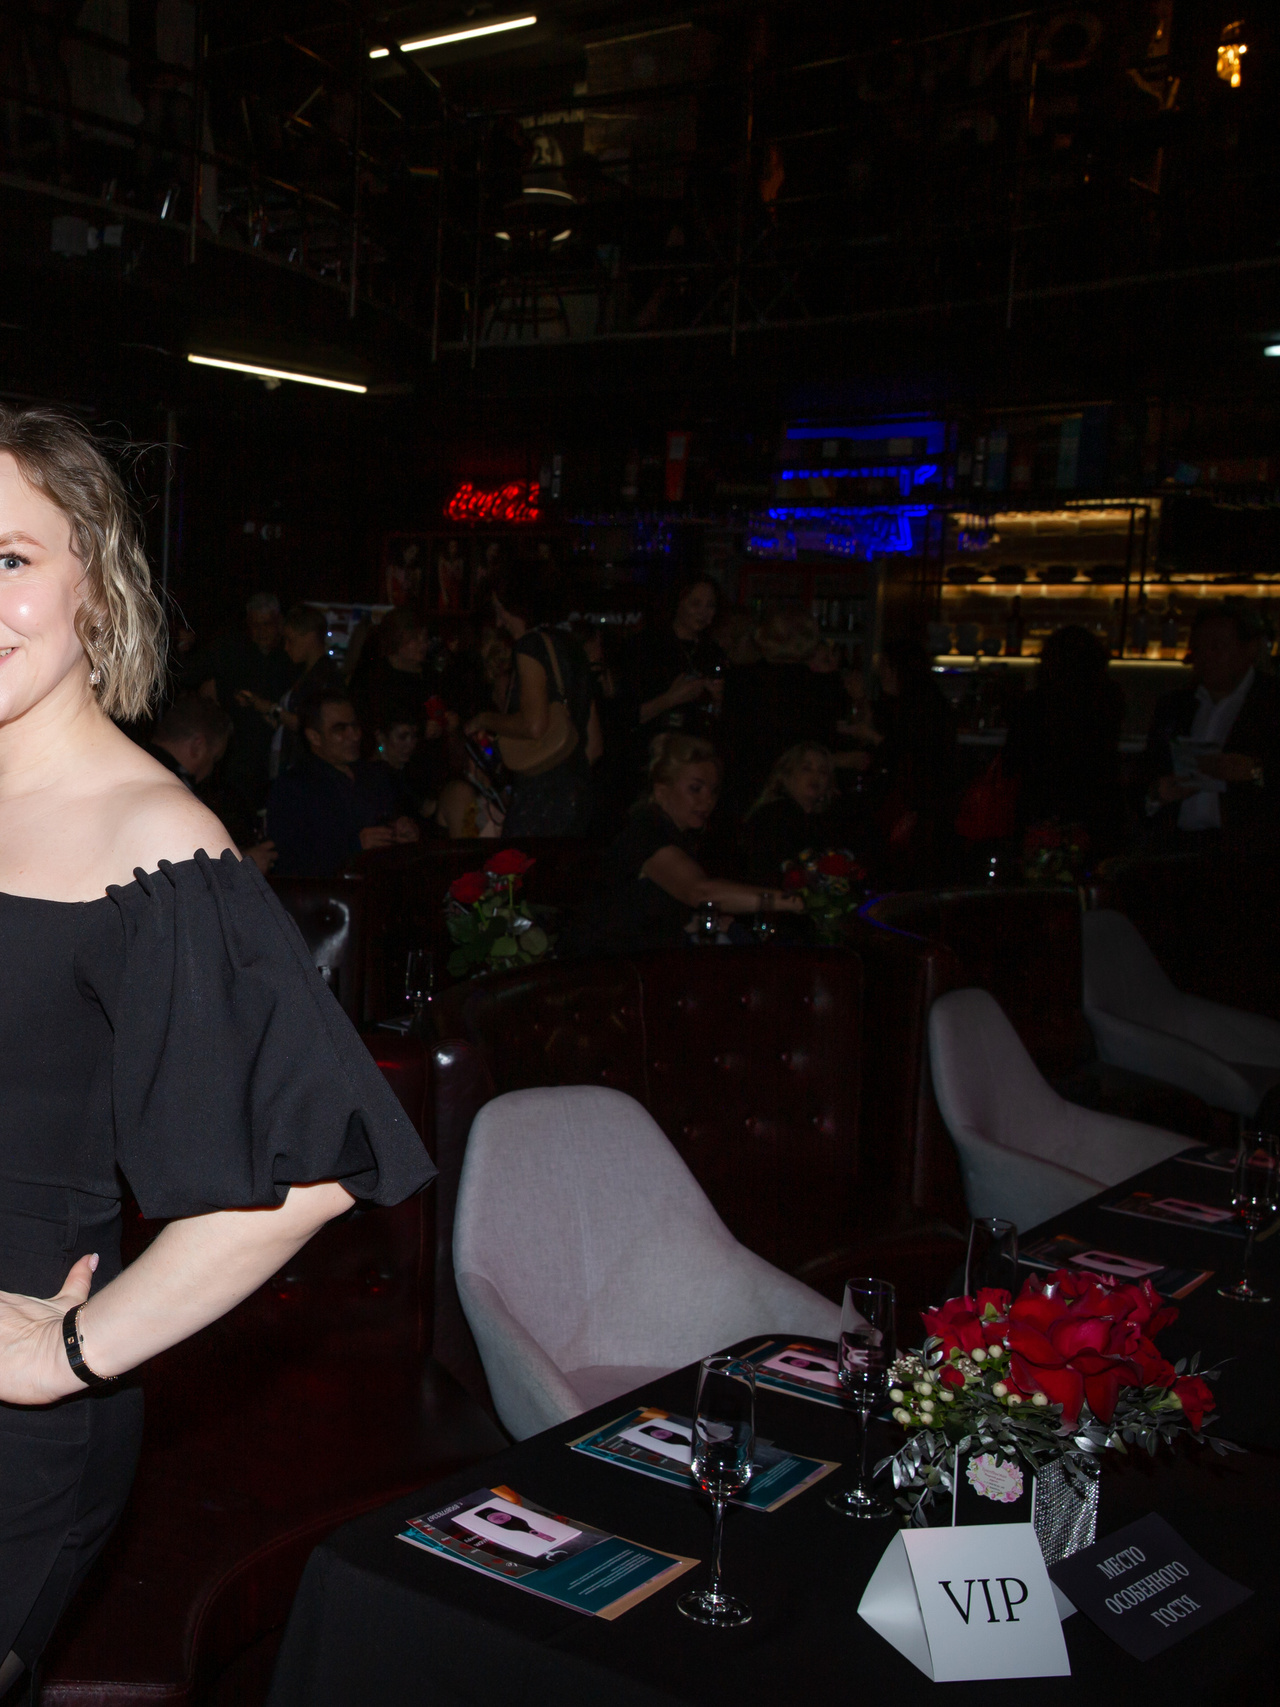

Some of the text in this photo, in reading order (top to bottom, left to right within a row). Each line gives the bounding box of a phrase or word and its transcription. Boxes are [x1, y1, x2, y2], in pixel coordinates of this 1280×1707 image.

[1096, 1546, 1146, 1580] МЕСТО
[938, 1577, 1028, 1625] VIP
[1105, 1561, 1190, 1614] ОСОБЕННОГО
[1150, 1594, 1201, 1627] ГОСТЯ
